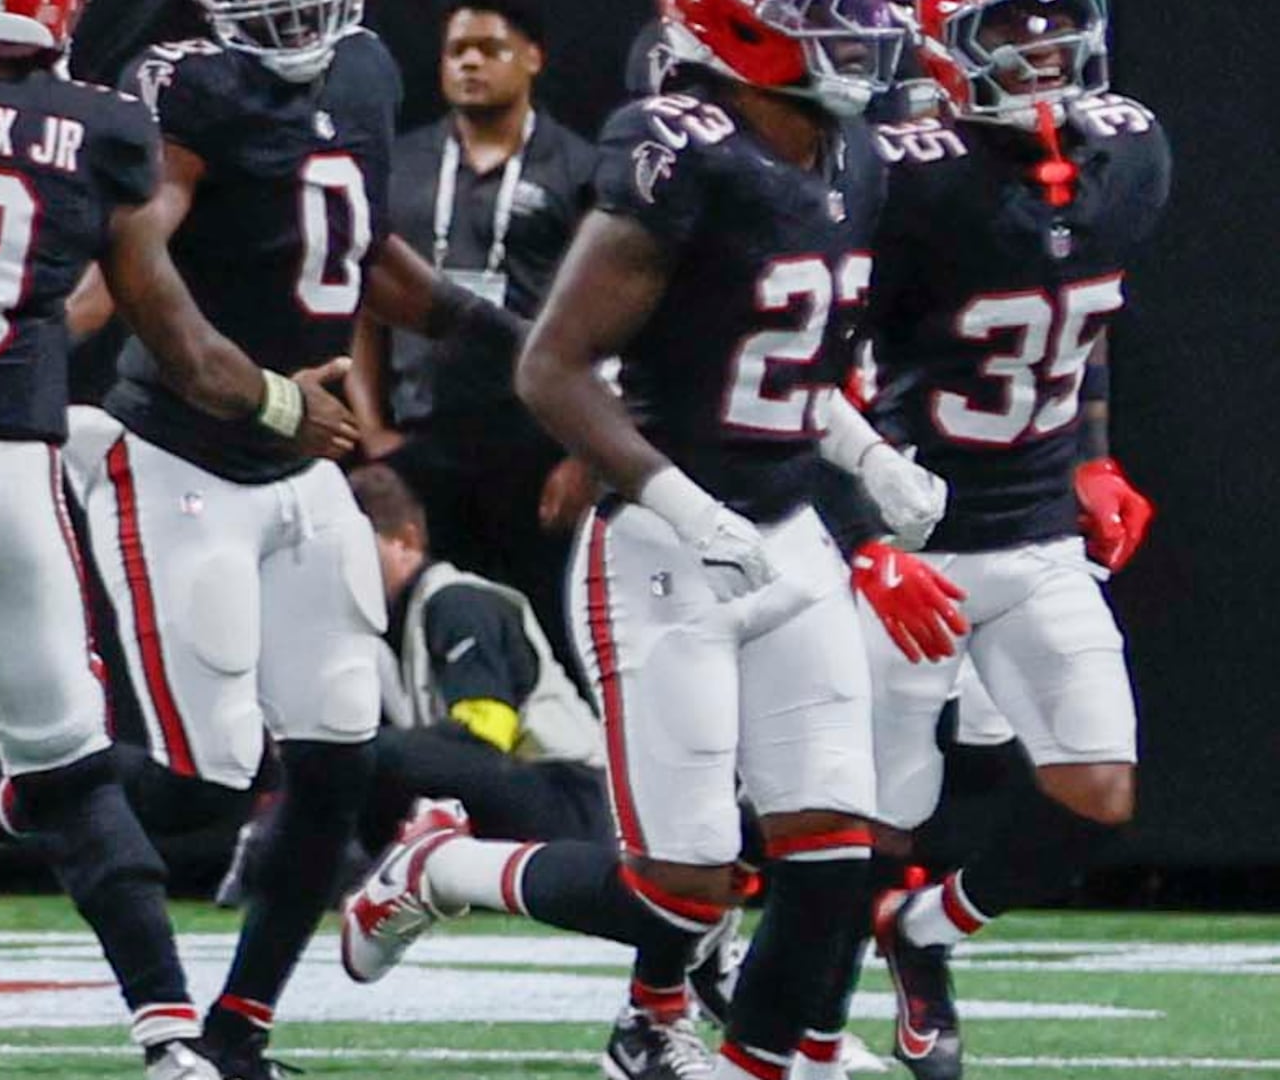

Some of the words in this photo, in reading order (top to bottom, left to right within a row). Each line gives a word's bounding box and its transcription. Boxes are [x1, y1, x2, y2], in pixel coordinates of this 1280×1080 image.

[30, 115, 86, 171] JR
[295, 153, 372, 316] 0
[936, 271, 1124, 445] 35
